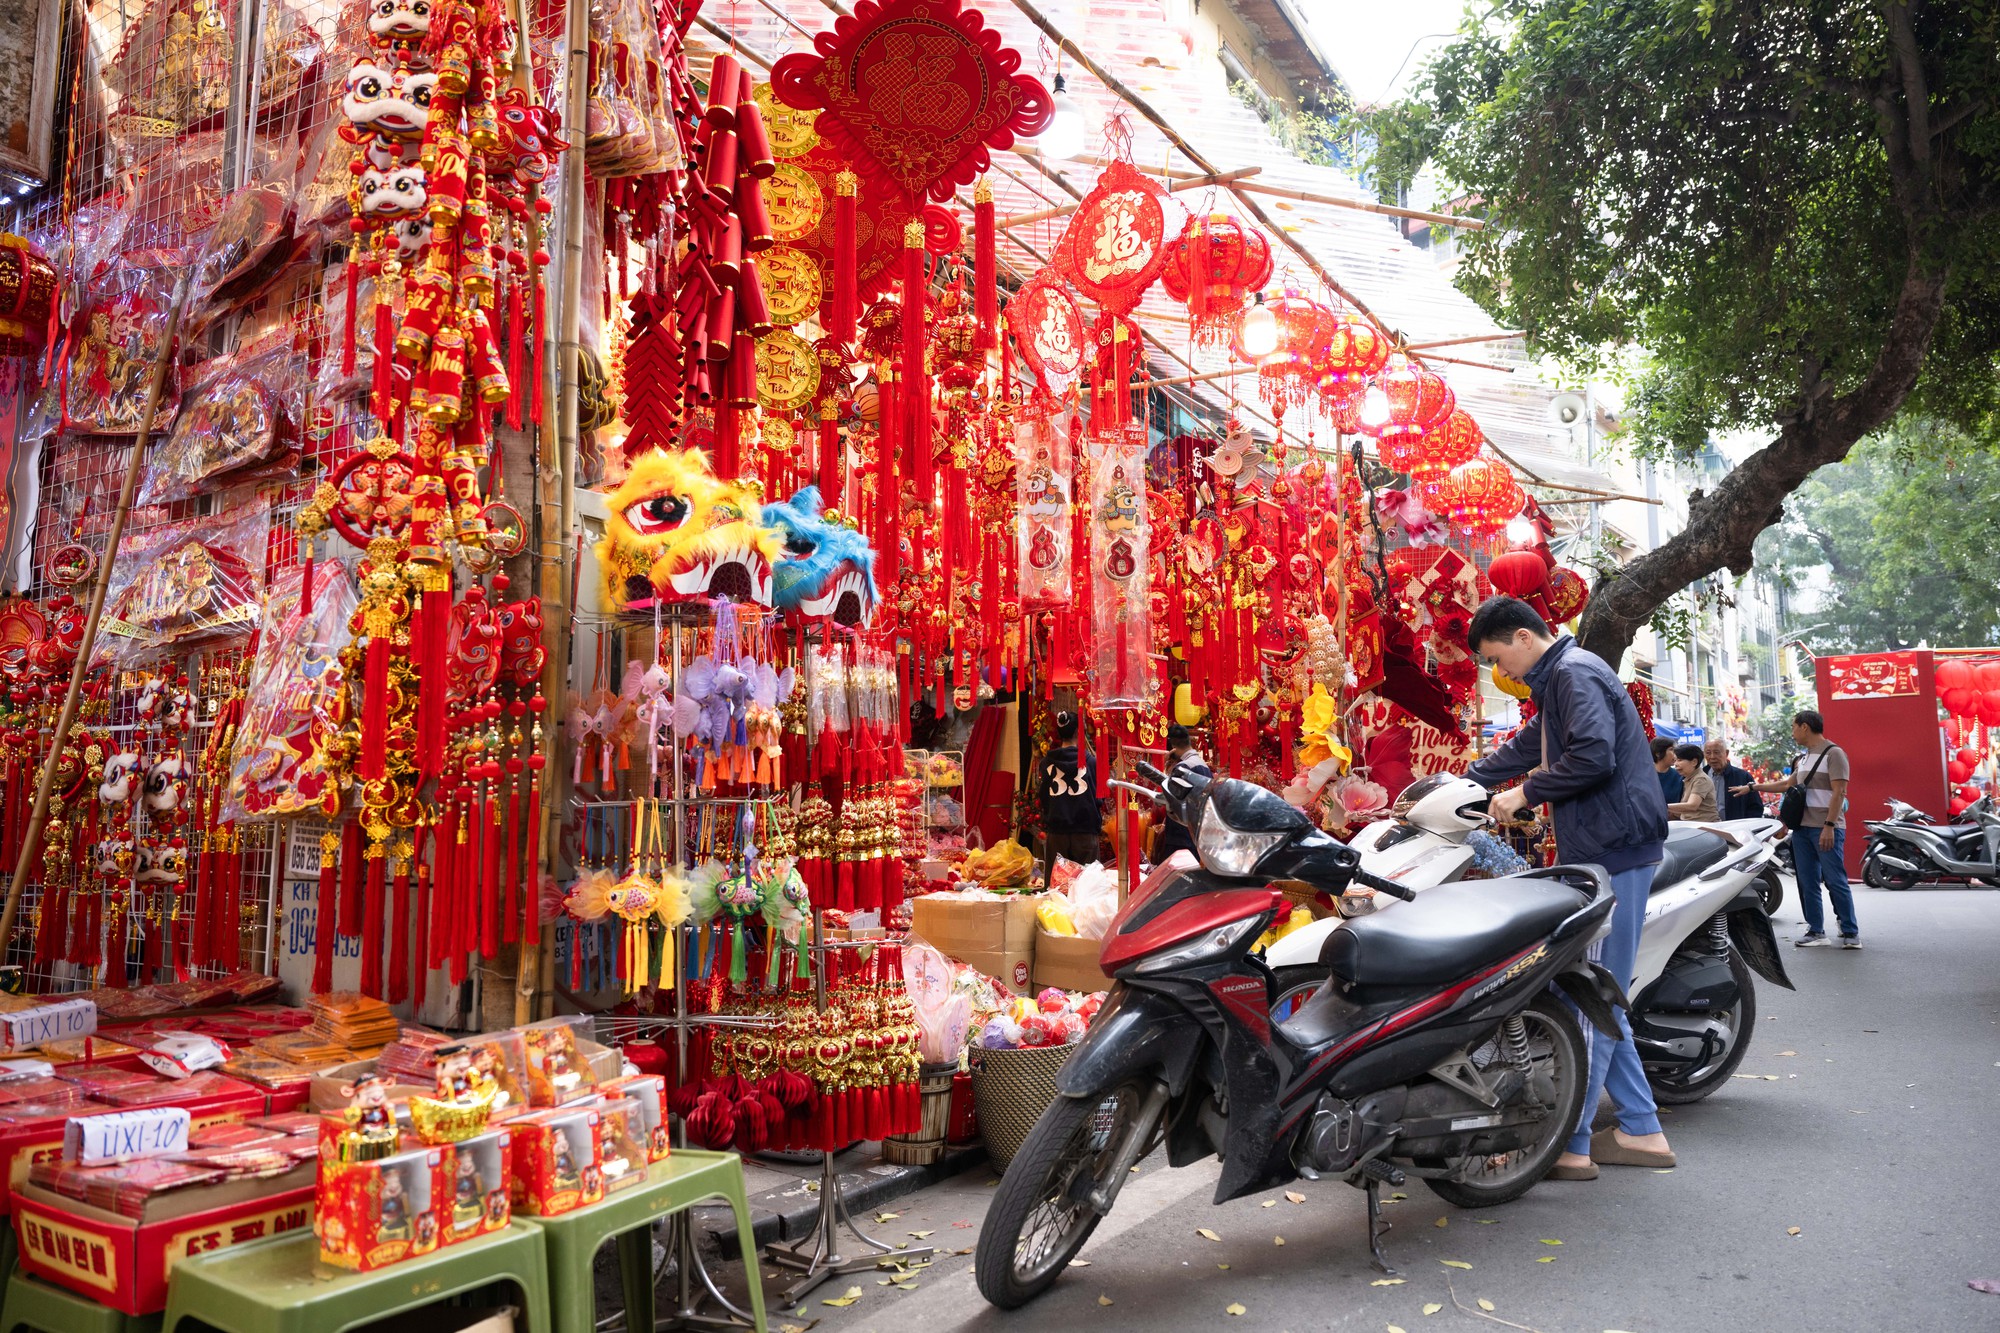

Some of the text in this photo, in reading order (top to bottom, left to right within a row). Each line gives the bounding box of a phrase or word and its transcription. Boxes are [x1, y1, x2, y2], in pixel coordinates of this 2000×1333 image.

[864, 32, 971, 130] 福
[1095, 209, 1141, 262] 福
[1041, 305, 1071, 352] 福
[819, 348, 842, 368] 平安
[985, 450, 1005, 474] 福
[1046, 764, 1088, 797] 33
[291, 844, 305, 870] 056
[1505, 943, 1549, 980] RSX
[1222, 981, 1261, 993] HONDA
